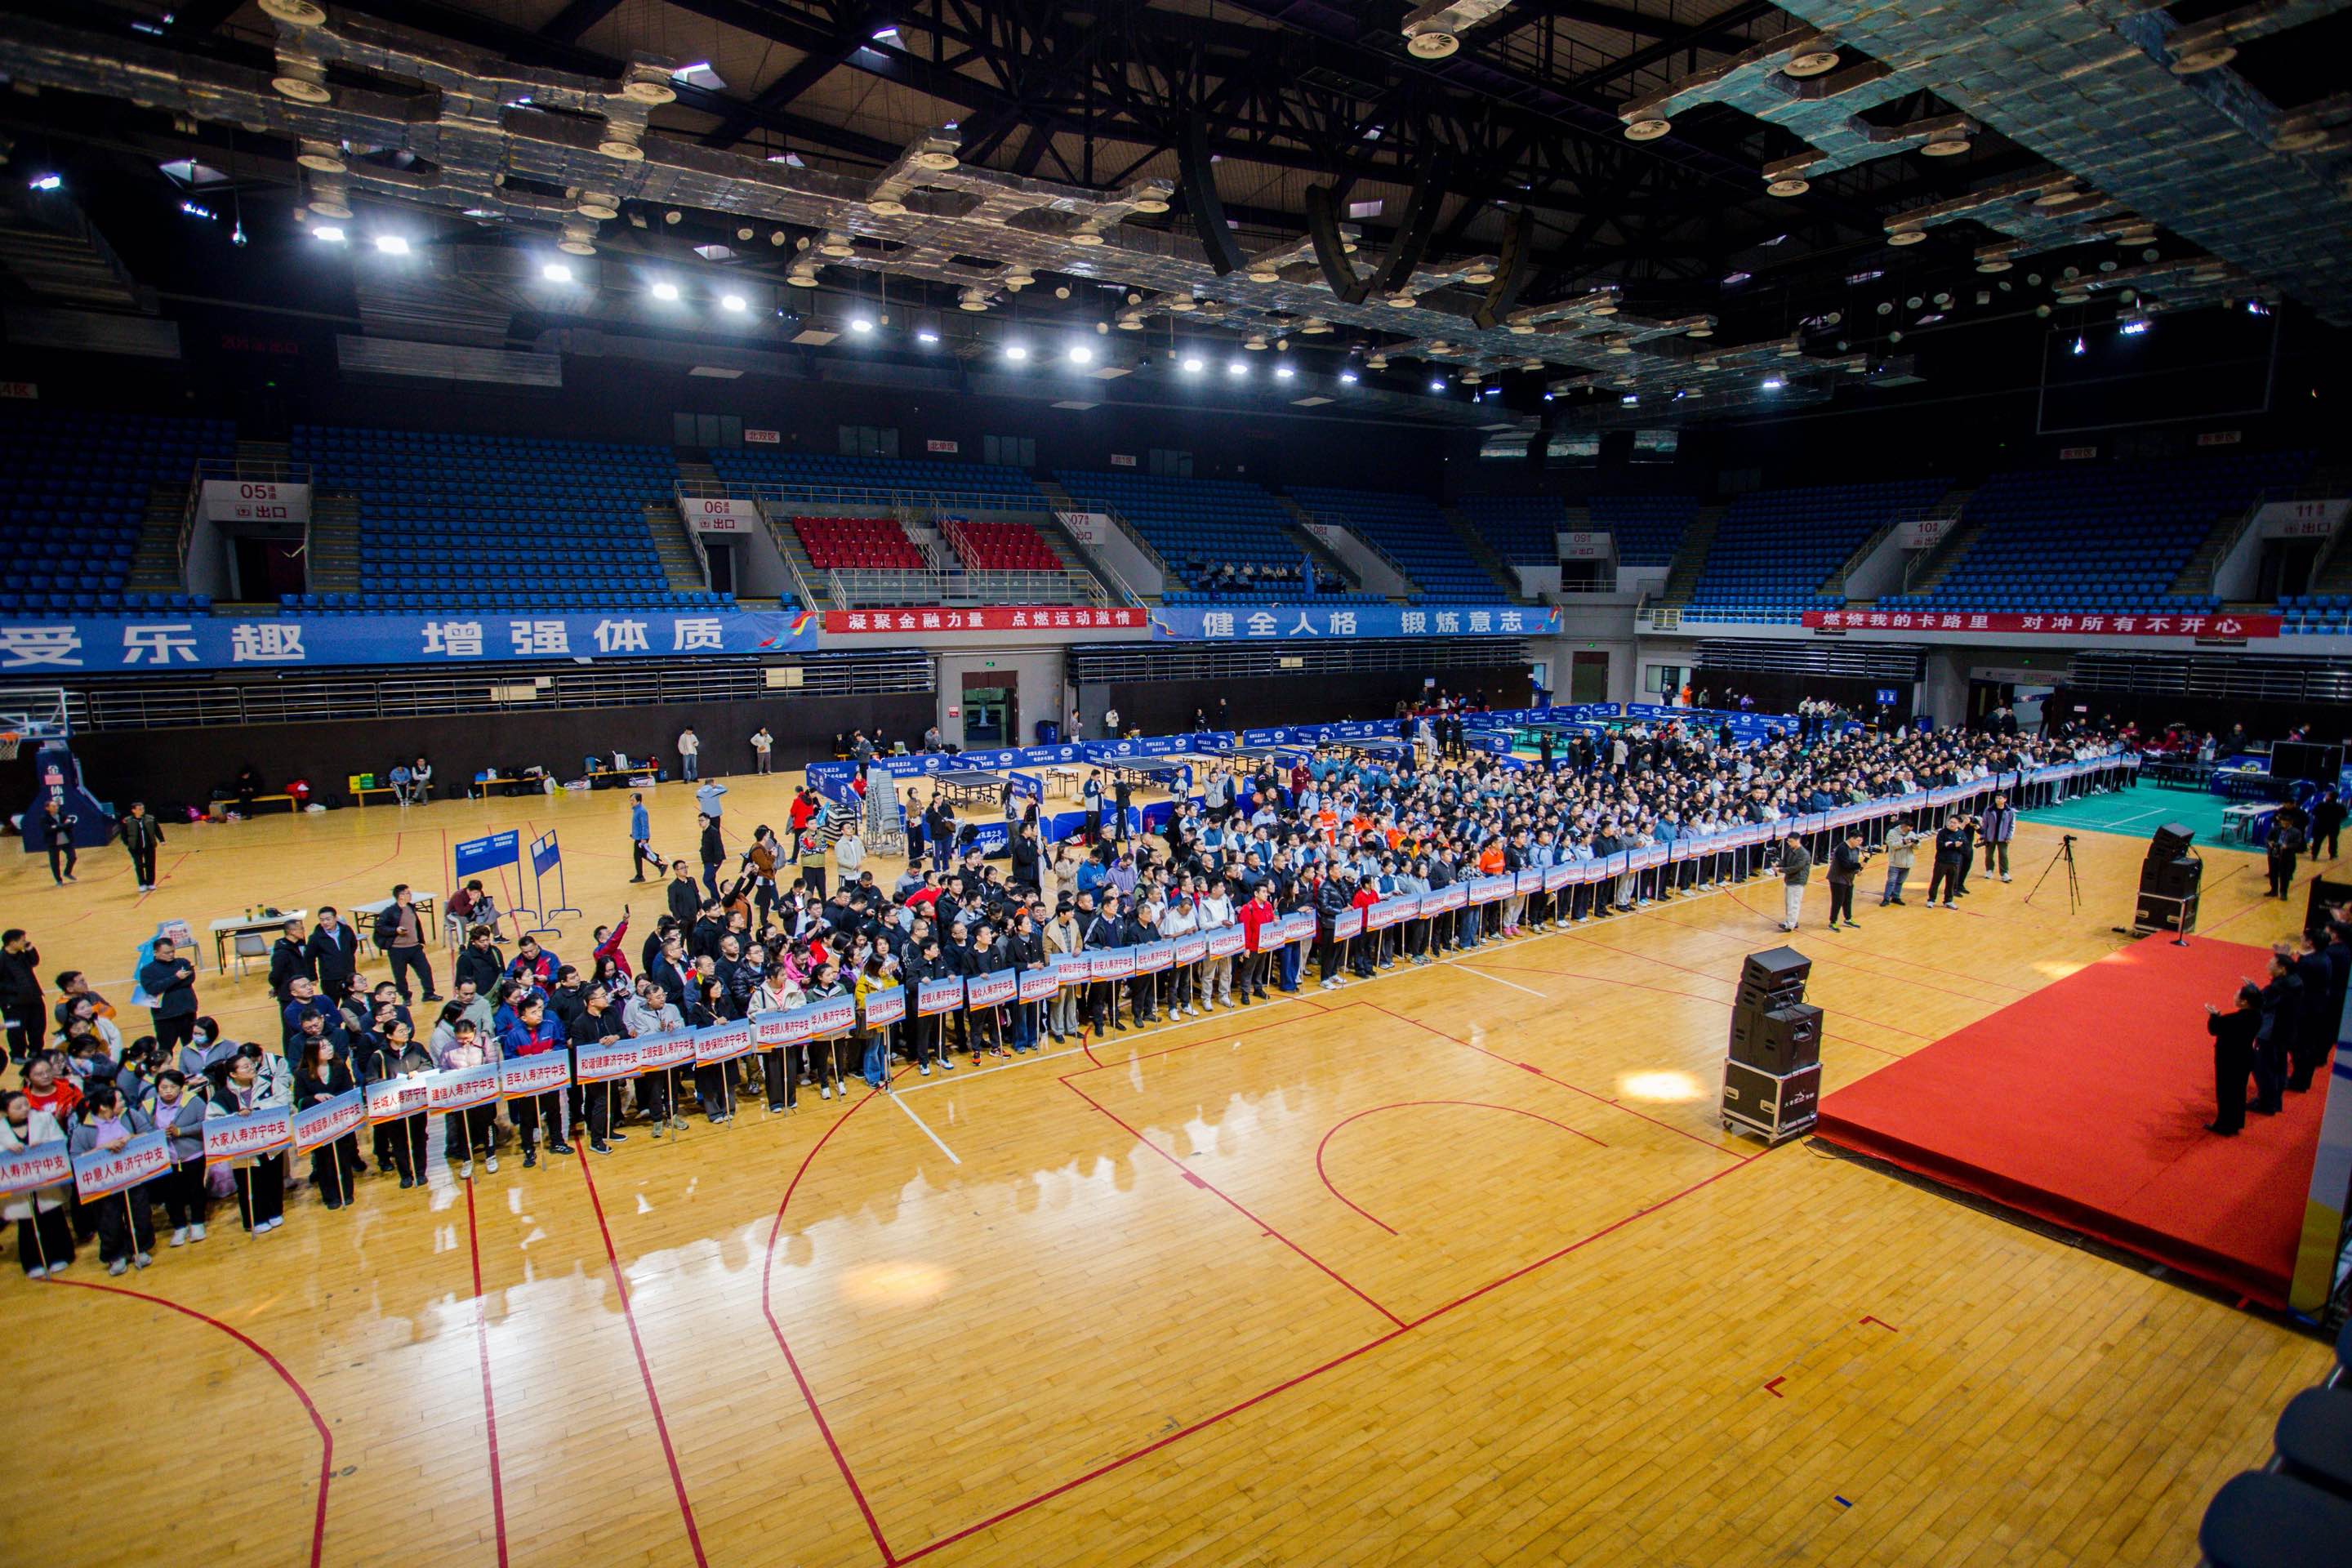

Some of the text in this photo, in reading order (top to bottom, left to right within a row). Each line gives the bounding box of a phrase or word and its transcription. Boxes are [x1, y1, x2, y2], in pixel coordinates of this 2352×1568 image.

[241, 484, 266, 499] 05
[256, 506, 287, 519] 出口
[705, 501, 723, 514] 06
[2296, 504, 2313, 517] 11
[713, 518, 735, 530] 出口
[1071, 514, 1084, 525] 07
[1918, 523, 1932, 533] 10
[1313, 526, 1324, 536] 08
[848, 610, 1130, 630] 凝聚金融力量 点燃运动激情
[1202, 611, 1522, 637] 健全人格 锻炼意志
[1823, 612, 2242, 634] 燃烧我的卡路里 对冲所有不开心
[0, 617, 724, 666] 受乐趣 增强体质
[760, 1020, 808, 1037] 德华安顾人寿济宁中支
[641, 1039, 694, 1059] 工银安盛人寿济宁中支
[698, 1031, 748, 1054] 信泰保险济宁中支
[581, 1052, 637, 1071] 和谐健康济宁中支
[506, 1064, 566, 1086] 百年人寿济宁中支
[431, 1077, 495, 1101] 建信人寿济宁中支
[210, 1120, 287, 1148] 大家人寿济宁中支
[0, 1155, 65, 1181] 人寿济宁中支
[82, 1146, 164, 1185] 中意人寿济宁中支
